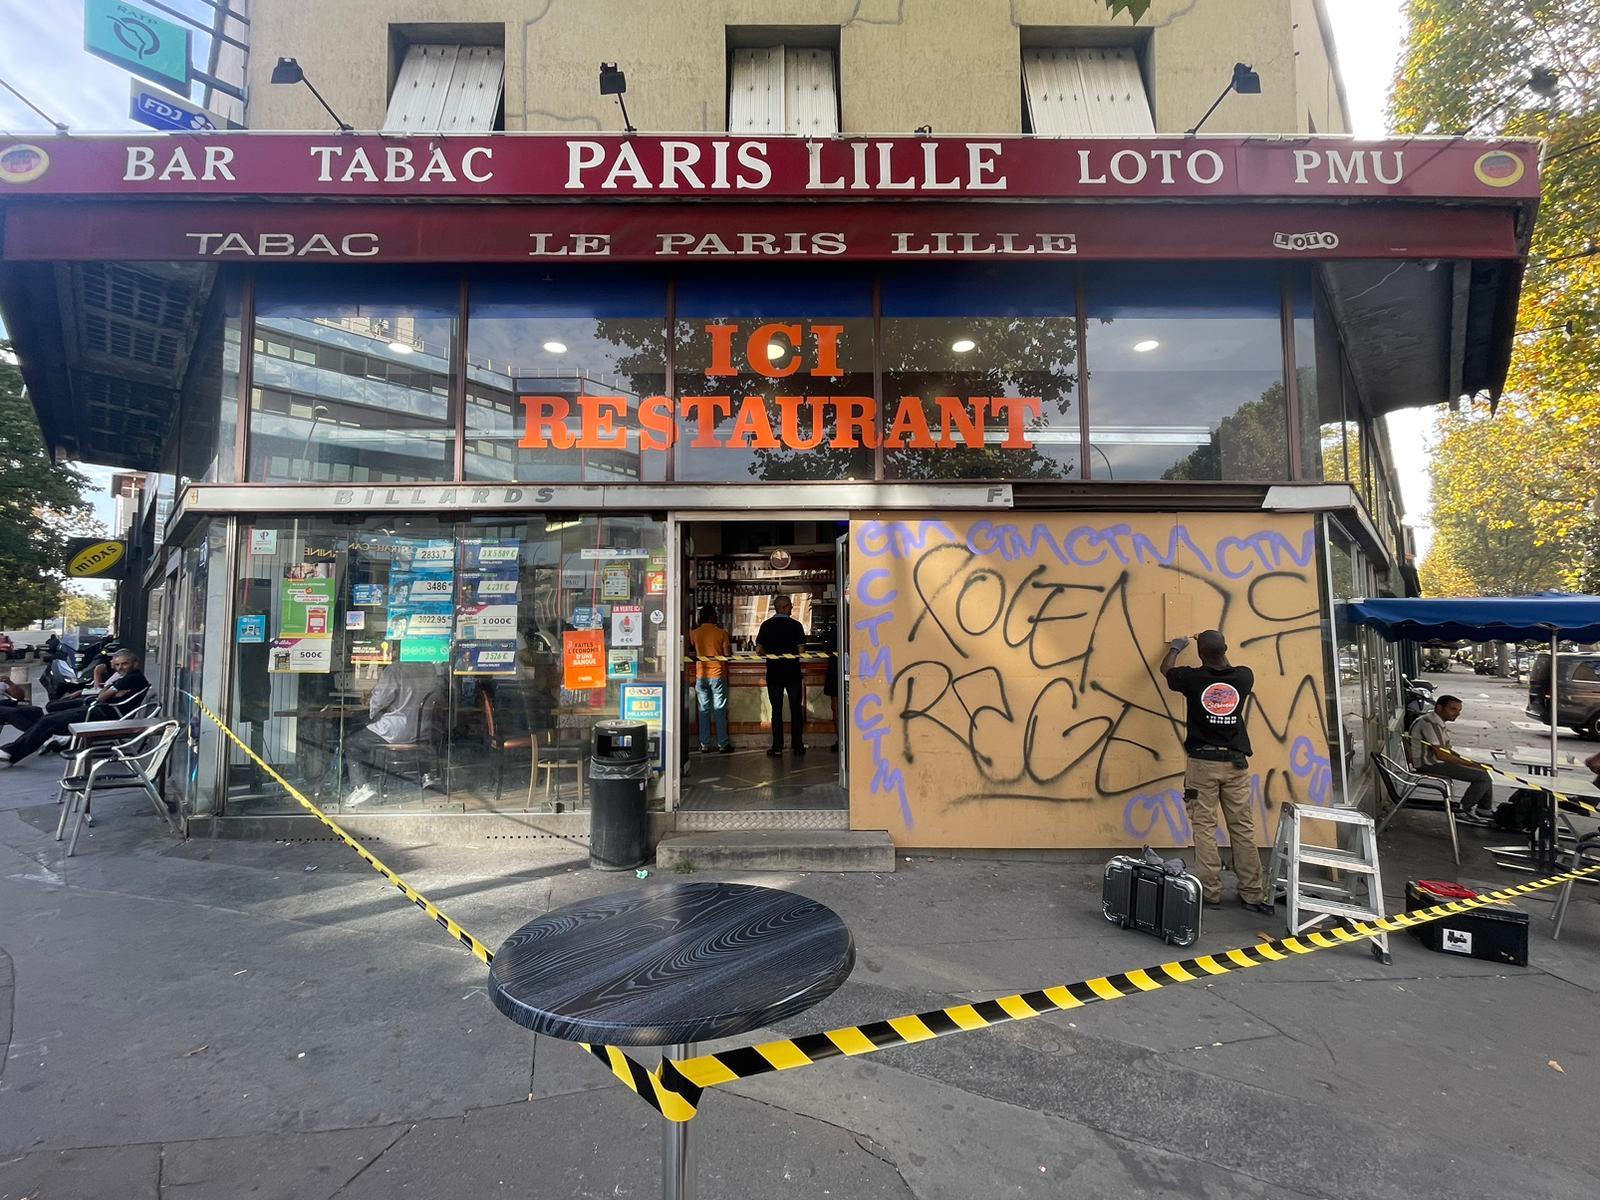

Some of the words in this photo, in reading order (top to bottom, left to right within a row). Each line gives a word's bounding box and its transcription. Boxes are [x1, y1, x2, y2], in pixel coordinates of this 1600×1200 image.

[117, 4, 159, 25] RATP
[143, 98, 183, 121] FDJ
[123, 146, 236, 182] BAR
[310, 146, 494, 183] TABAC
[564, 141, 772, 190] PARIS
[805, 141, 1007, 190] LILLE
[1077, 149, 1224, 185] LOTO
[1293, 149, 1404, 185] PMU
[186, 232, 380, 257] TABAC
[529, 233, 611, 256] LE
[655, 232, 847, 255] PARIS
[891, 232, 1077, 255] LILLE
[1272, 231, 1339, 251] LOTO
[704, 323, 845, 378] ICI
[518, 395, 1042, 451] RESTAURANT
[333, 487, 555, 505] BILLARDS
